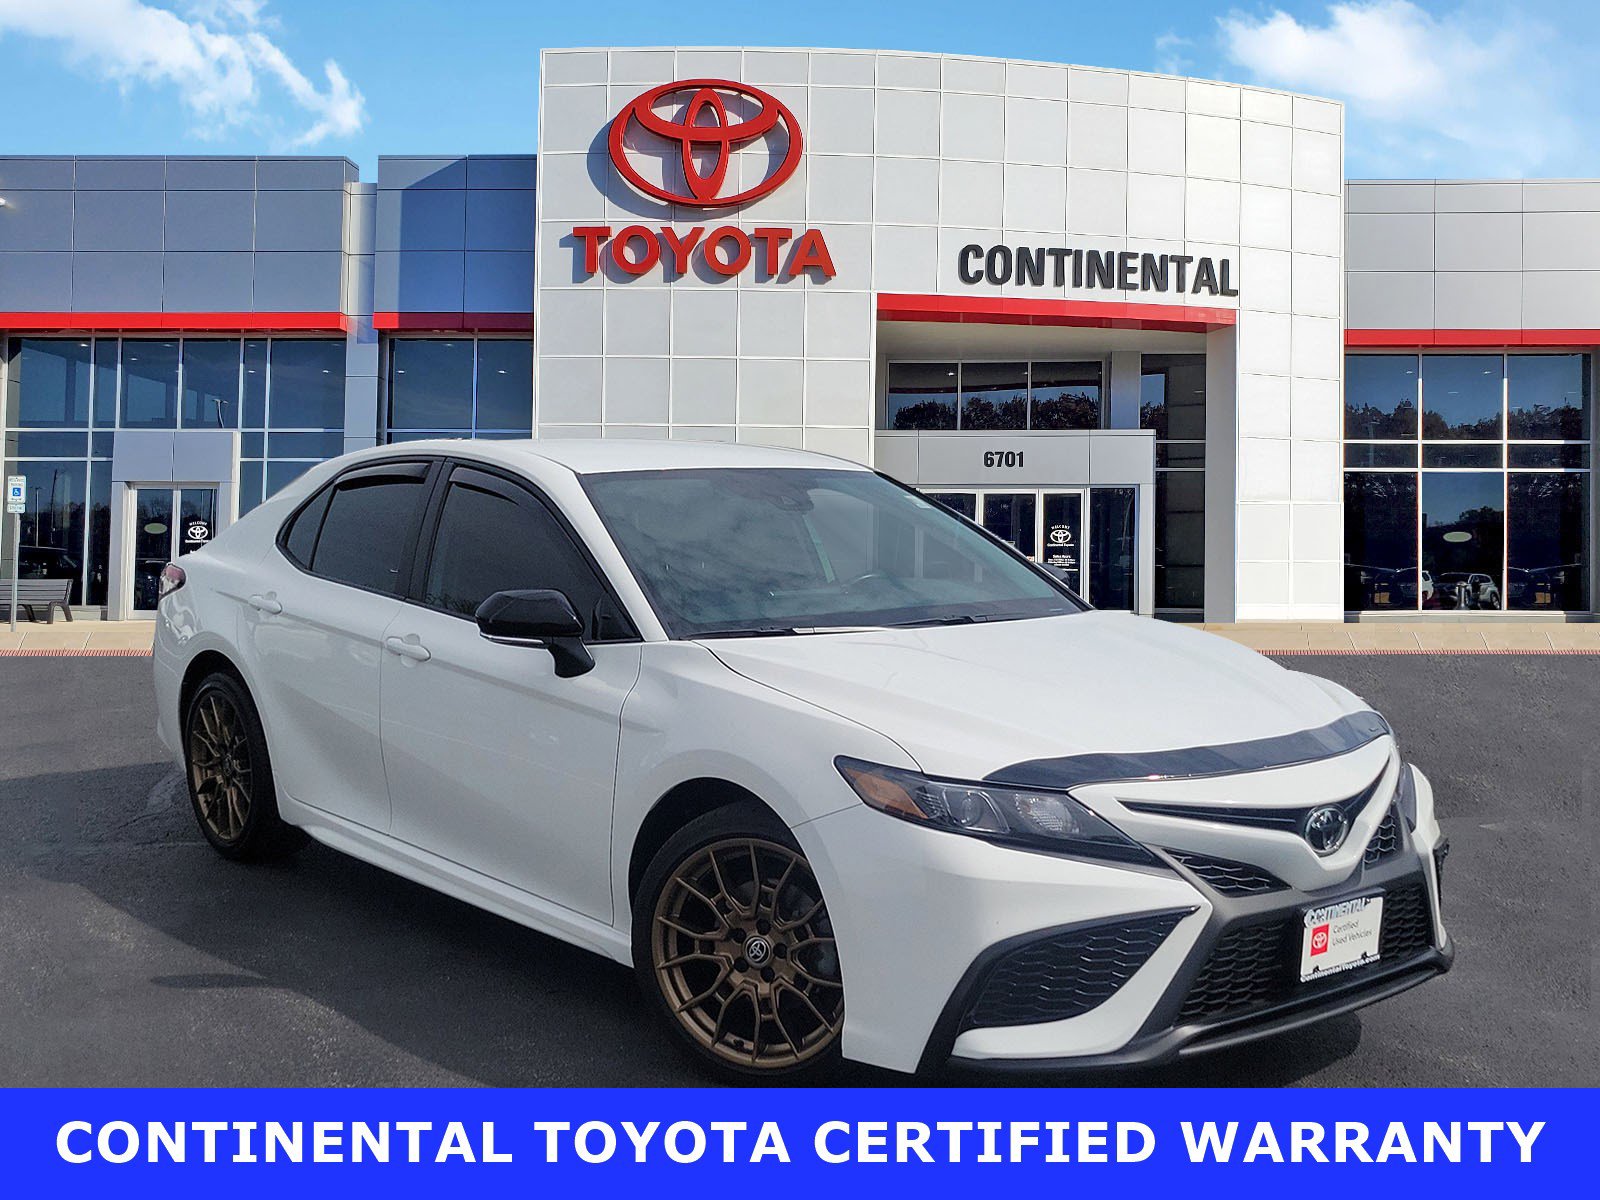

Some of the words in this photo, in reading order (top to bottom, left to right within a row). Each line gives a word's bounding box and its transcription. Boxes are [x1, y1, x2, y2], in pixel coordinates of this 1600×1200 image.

[573, 225, 836, 277] TOYOTA
[959, 244, 1239, 297] CONTINENTAL
[983, 451, 1024, 468] 6701
[1304, 898, 1365, 927] CONTINENTAL
[1332, 935, 1347, 946] Used
[1348, 928, 1374, 943] Vehicles
[1333, 920, 1359, 934] Certified
